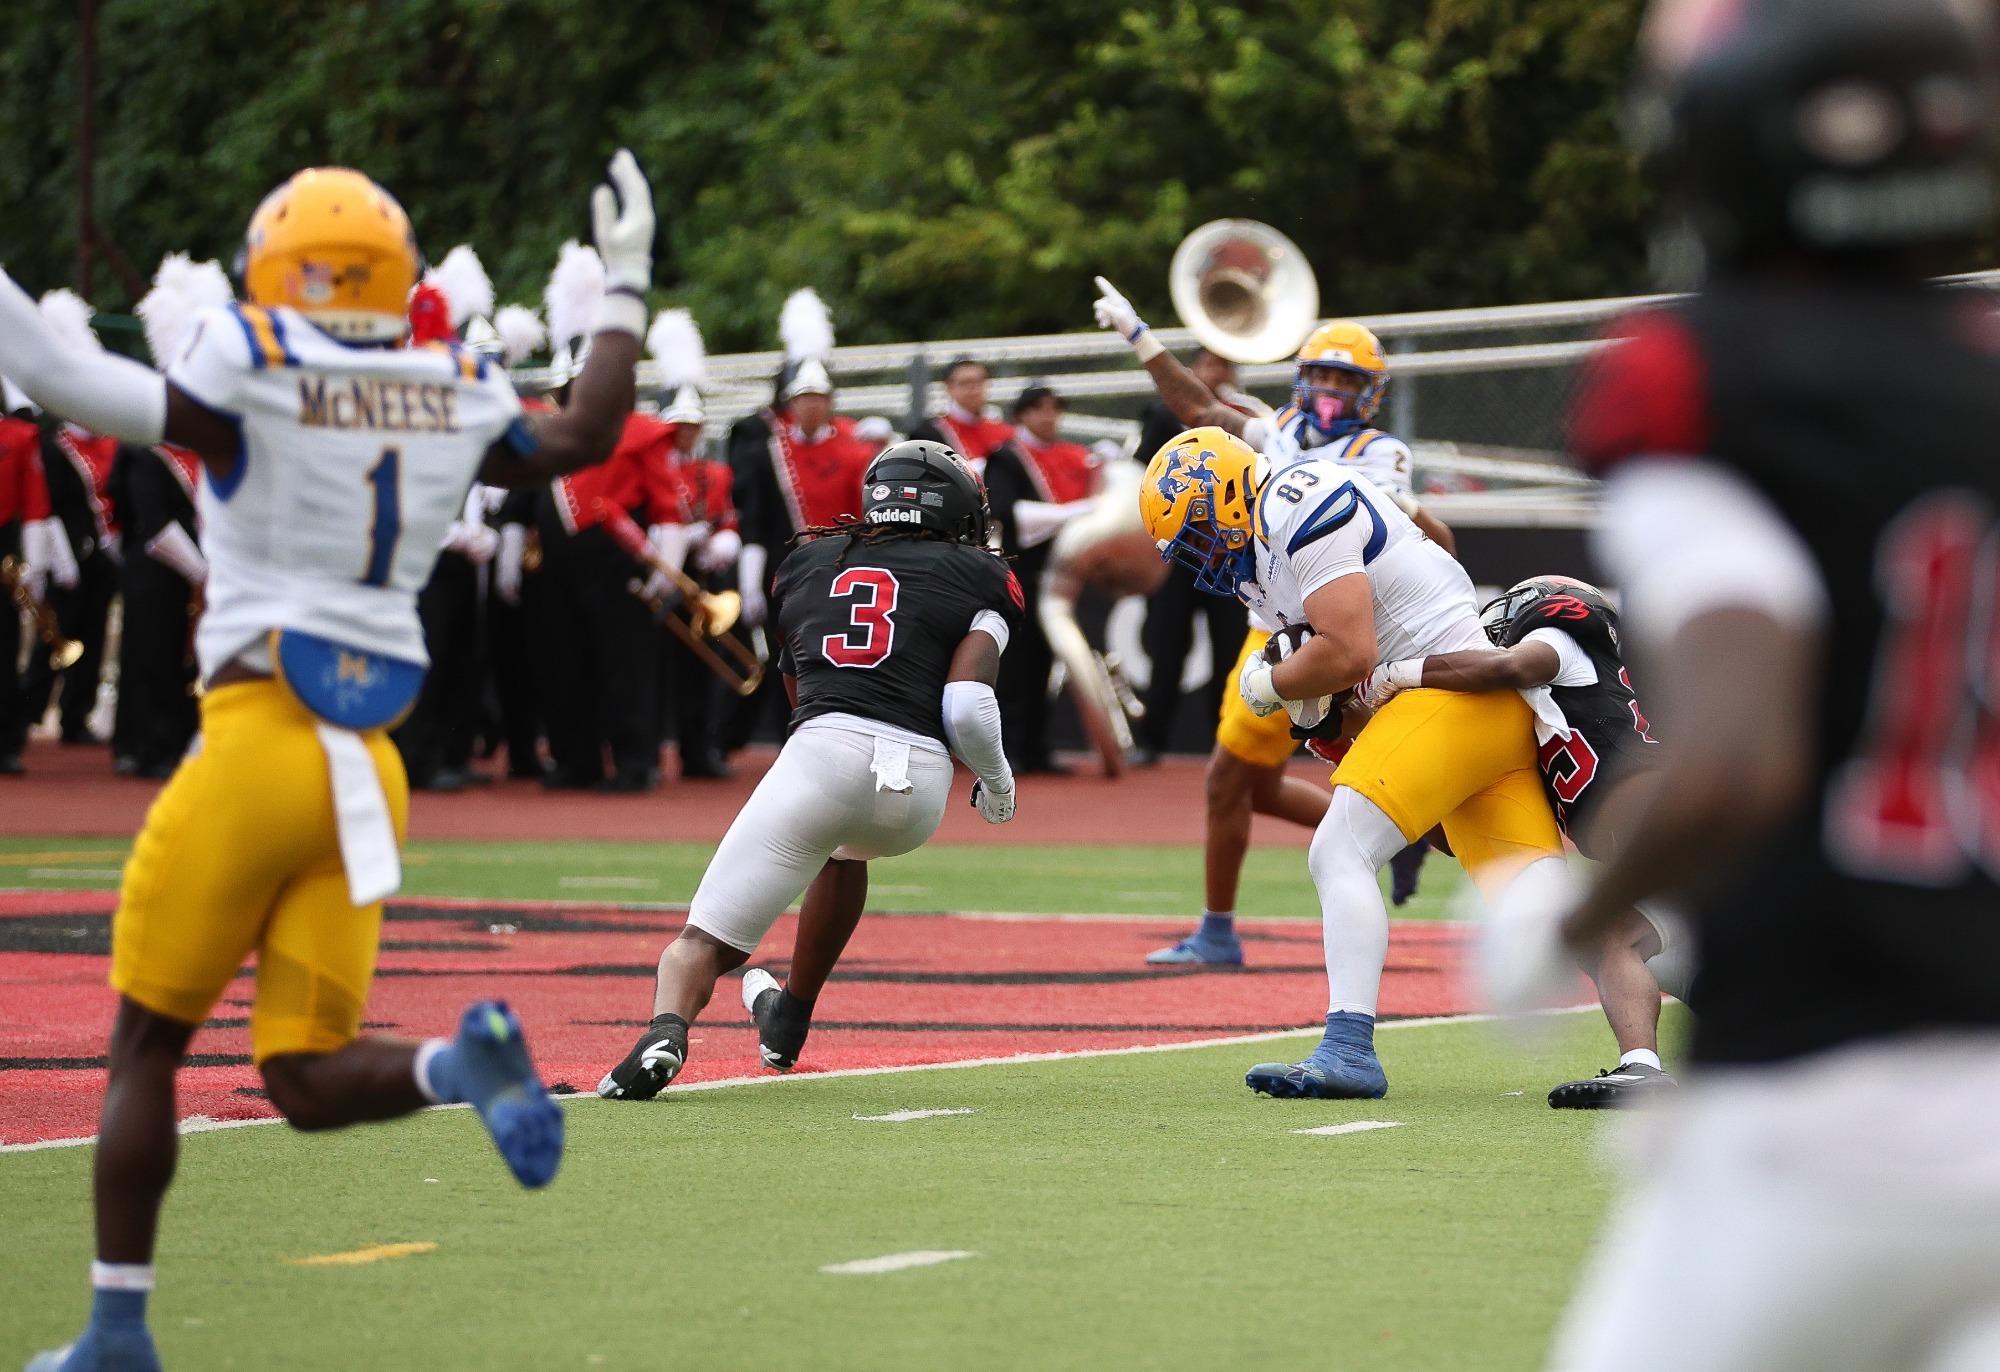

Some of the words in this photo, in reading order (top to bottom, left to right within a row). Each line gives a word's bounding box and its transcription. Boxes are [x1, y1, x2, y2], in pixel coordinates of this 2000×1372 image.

[364, 444, 404, 588] 1
[870, 508, 922, 524] Riddell
[1276, 469, 1320, 505] 83
[822, 567, 899, 669] 3
